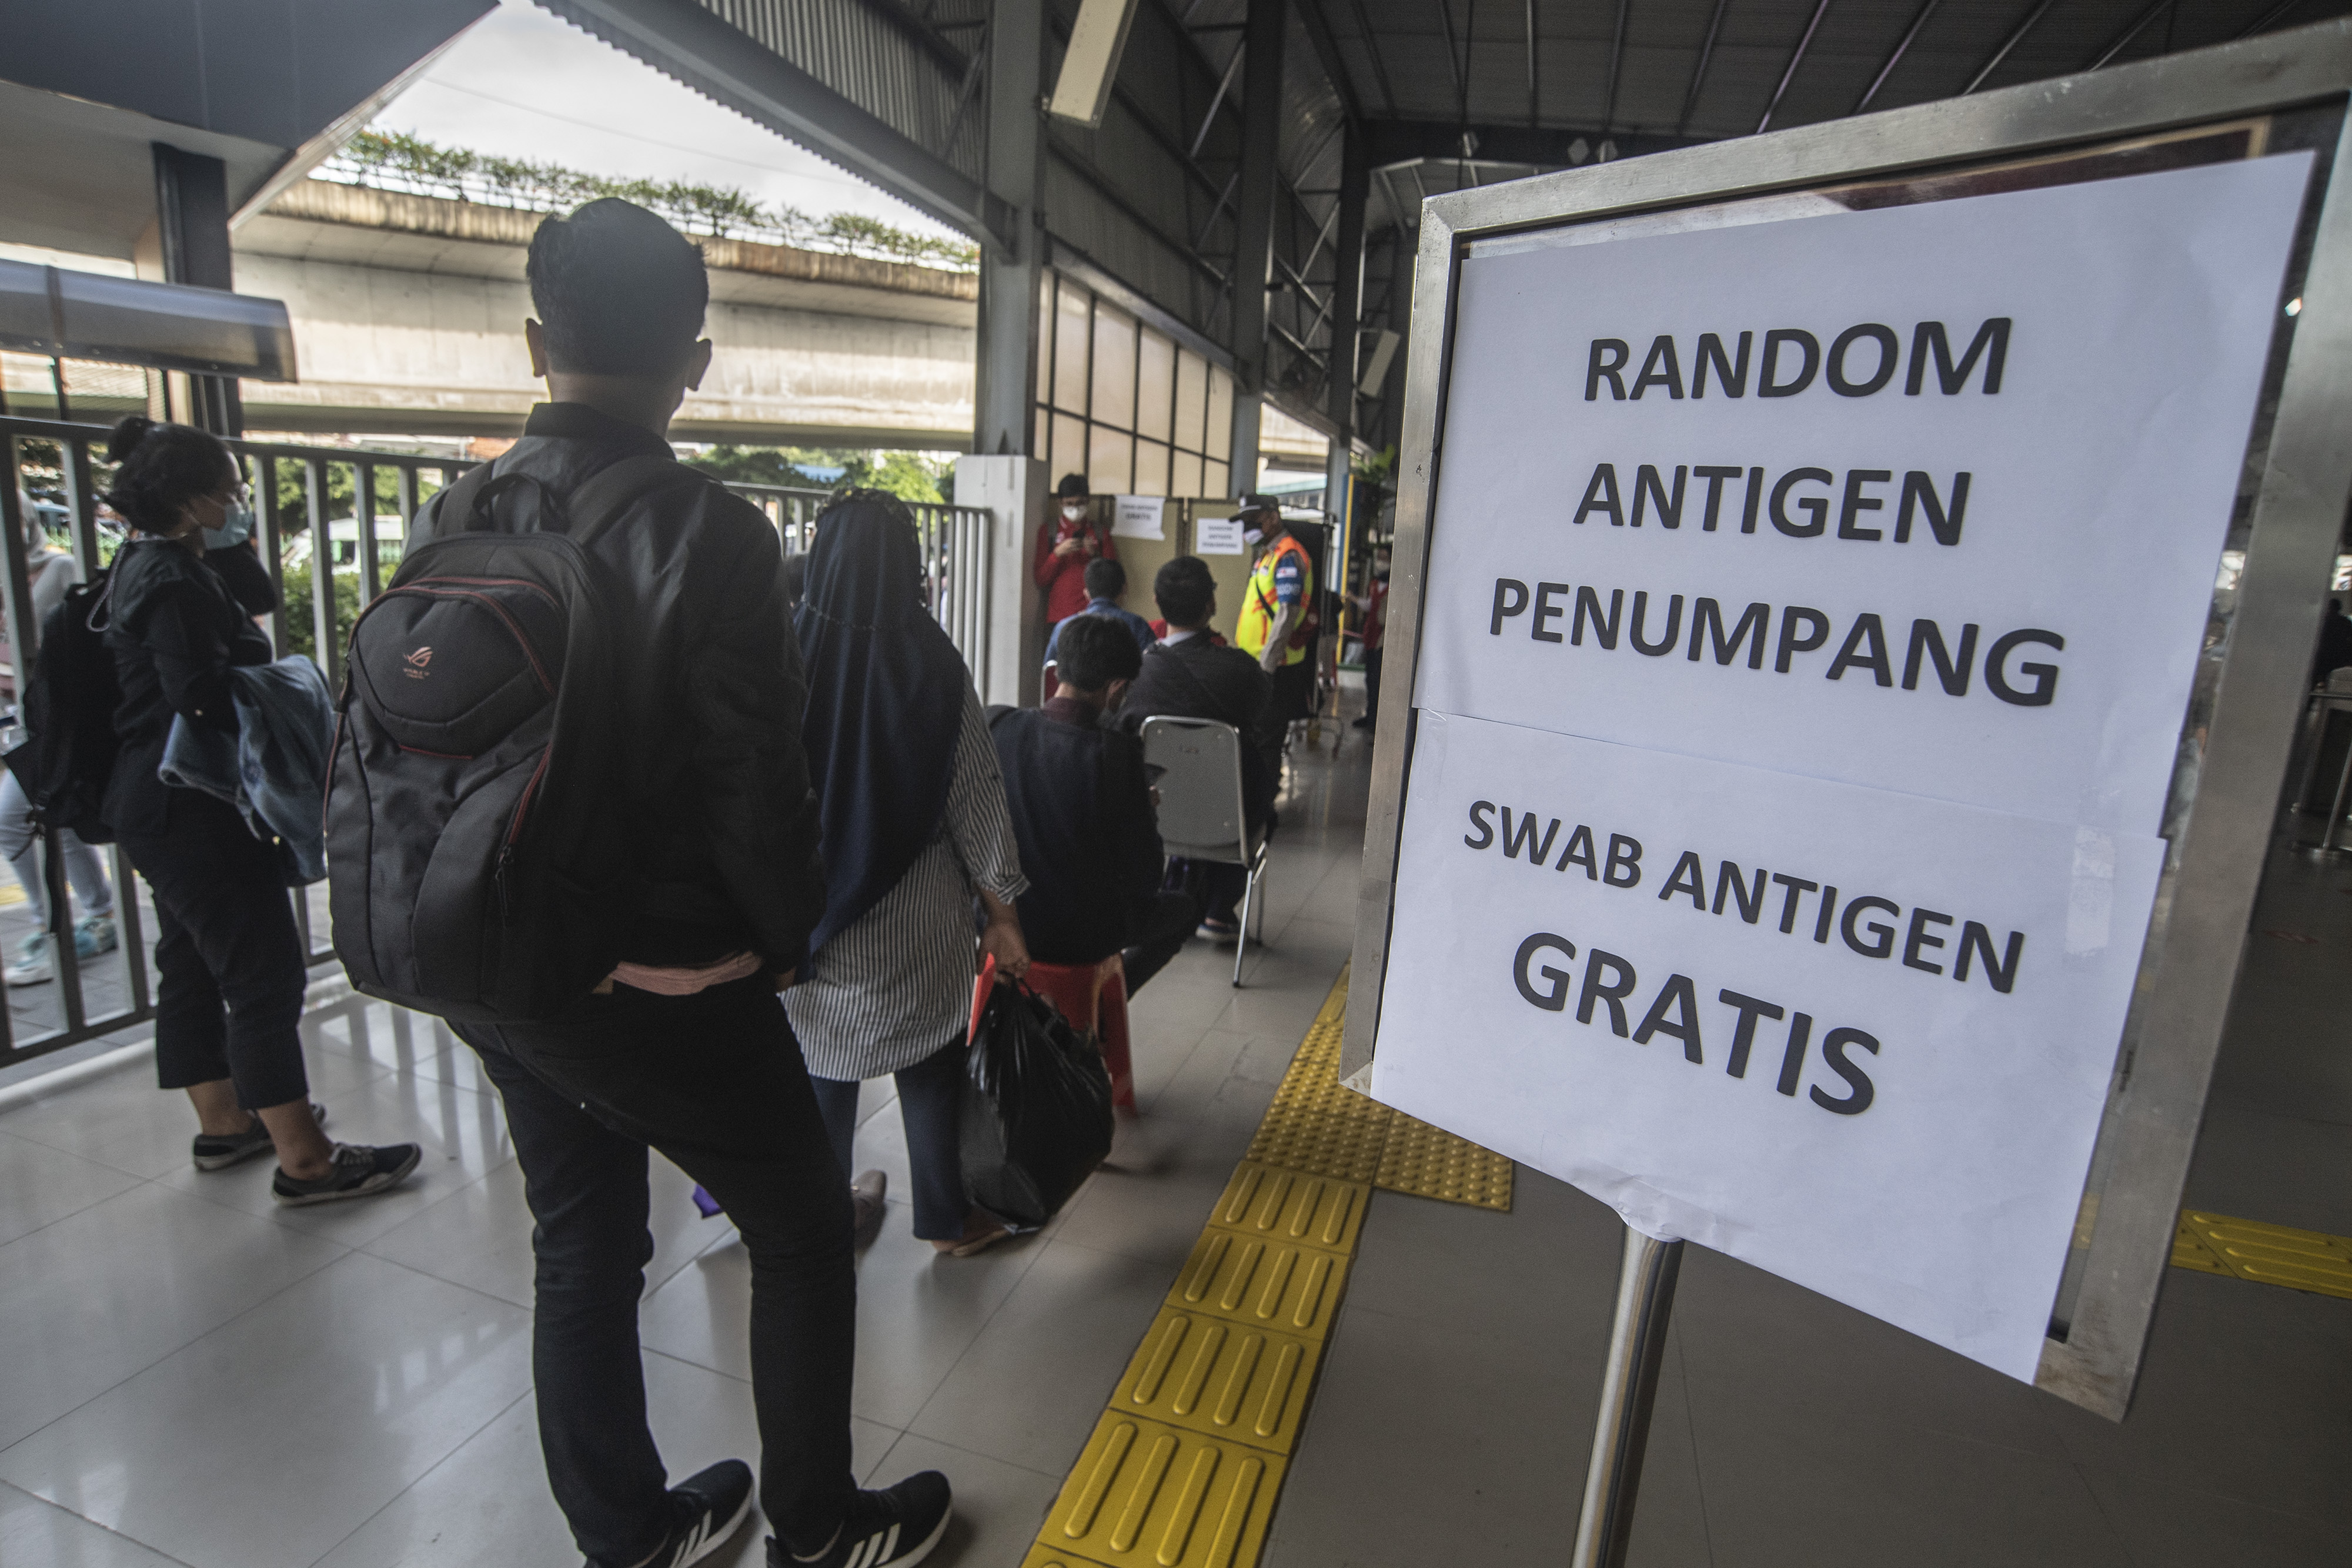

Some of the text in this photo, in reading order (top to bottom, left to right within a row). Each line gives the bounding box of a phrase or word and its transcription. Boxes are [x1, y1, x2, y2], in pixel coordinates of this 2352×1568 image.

[1584, 317, 2012, 402] RANDOM
[1573, 463, 1972, 547] ANTIGEN
[1490, 578, 2065, 707] PENUMPANG
[1464, 800, 2024, 994] SWAB ANTIGEN
[1513, 932, 1880, 1115] GRATIS
